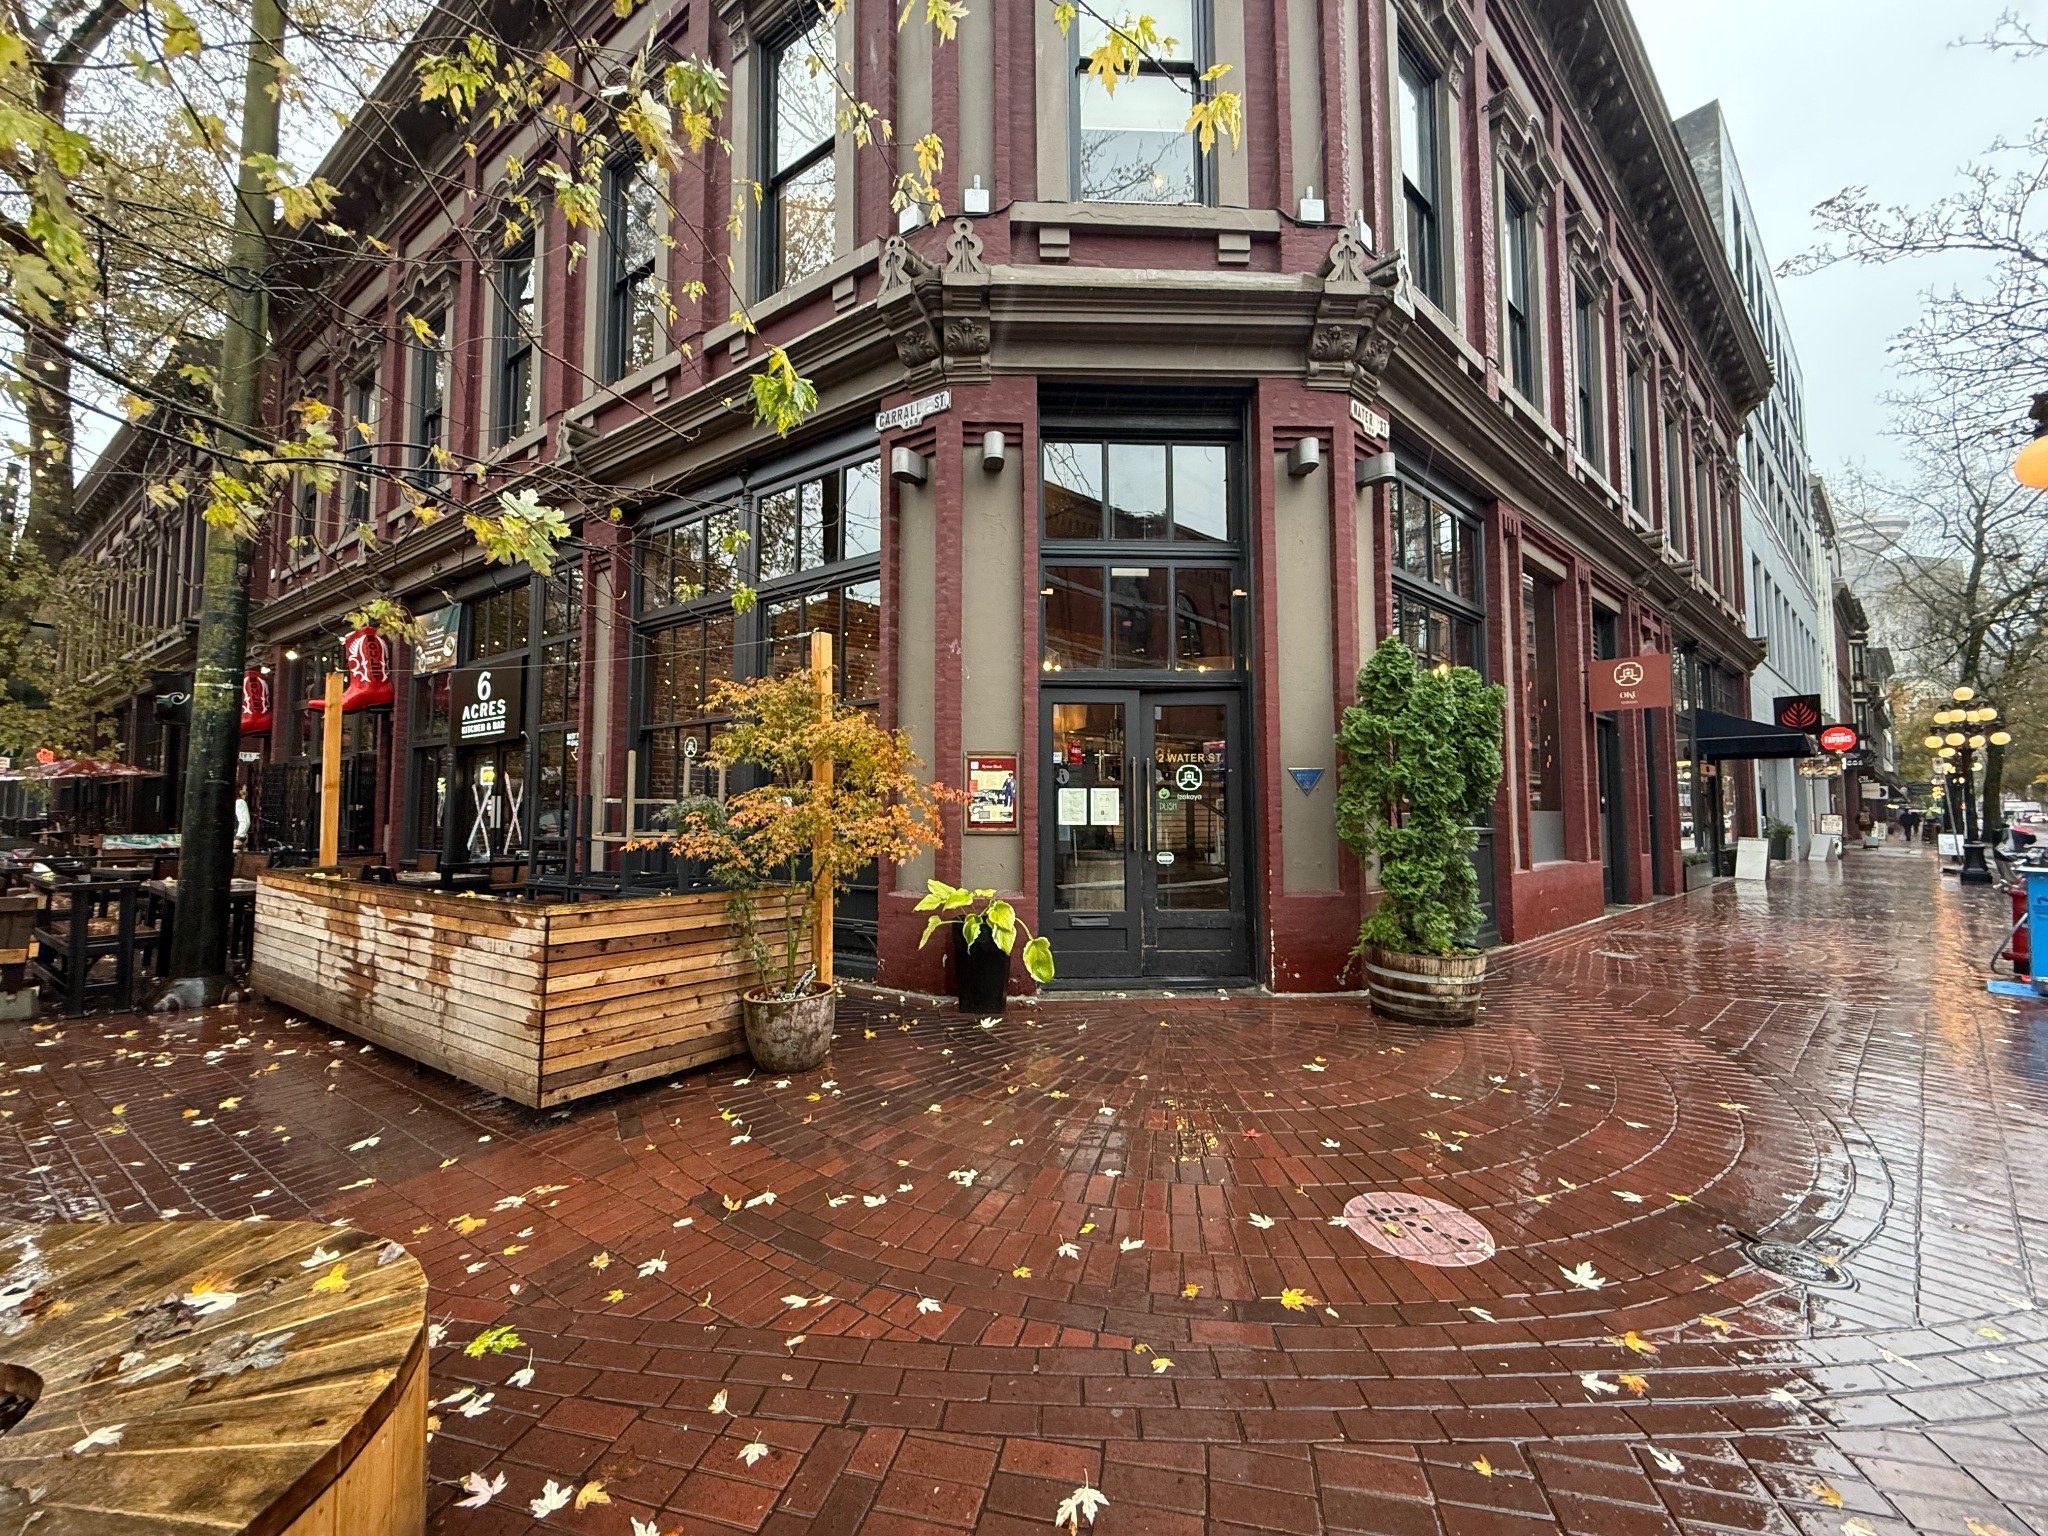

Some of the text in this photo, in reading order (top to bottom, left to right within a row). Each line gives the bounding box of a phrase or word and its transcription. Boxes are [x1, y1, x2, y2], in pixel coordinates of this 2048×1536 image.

[879, 403, 921, 428] CARRALL
[1353, 402, 1373, 427] WATER
[477, 671, 491, 701] 6
[462, 699, 506, 720] ACRES
[461, 723, 486, 735] KITCHEN
[492, 720, 506, 730] BAR
[1158, 753, 1165, 763] 2
[1167, 753, 1205, 763] WATER
